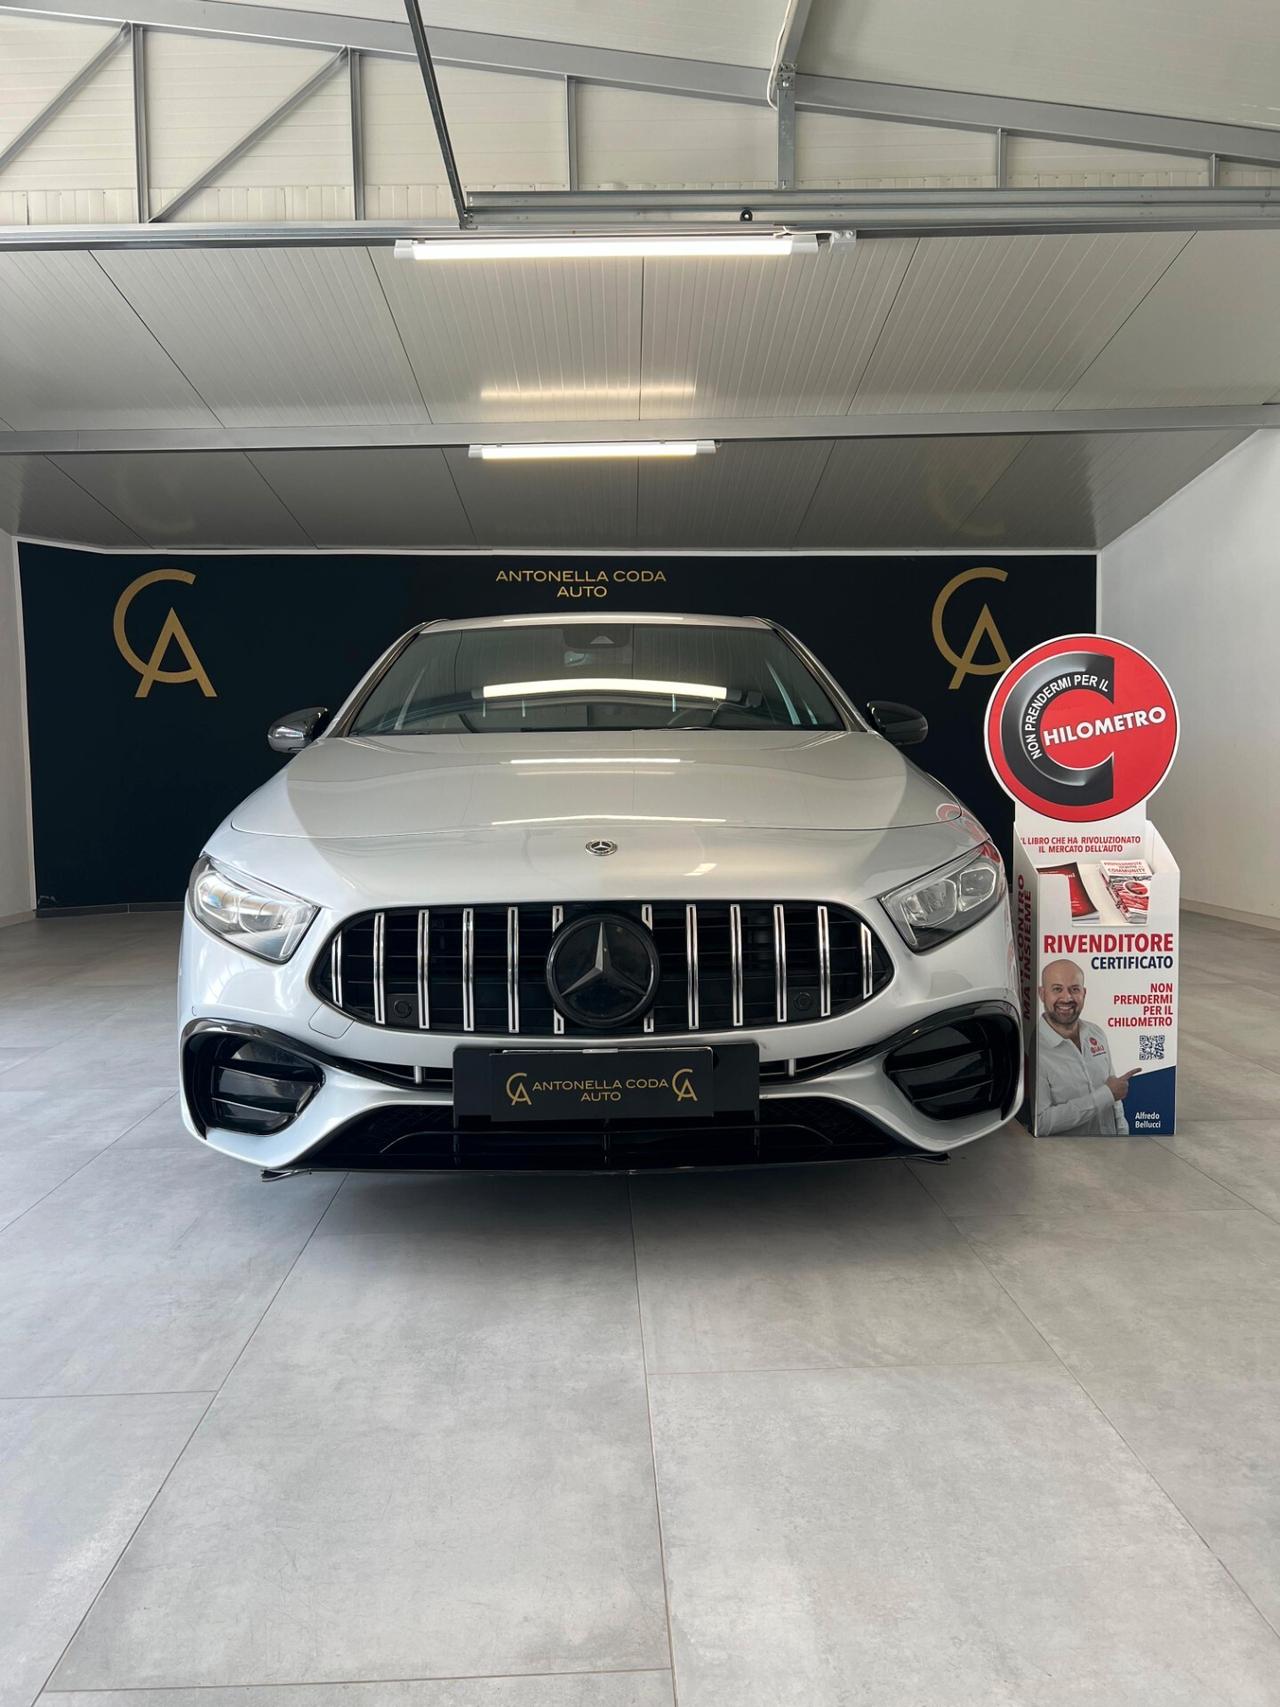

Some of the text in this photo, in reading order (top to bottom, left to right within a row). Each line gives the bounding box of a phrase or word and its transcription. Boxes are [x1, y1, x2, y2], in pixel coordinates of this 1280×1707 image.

[496, 570, 667, 582] ANTONELLA CODA
[557, 586, 607, 598] AUTO
[1024, 674, 1109, 760] NON PRENDERMI PER IL
[1028, 837, 1049, 845] LIBRO
[1051, 837, 1066, 845] CHE
[1068, 837, 1078, 845] HA
[1081, 836, 1141, 844] RIVOLUZIONATO
[1038, 845, 1123, 853] IL MERCATO DELL'AUTO
[1044, 934, 1173, 953] RIVENDITORE
[1091, 956, 1173, 969] CERTIFICATO
[1150, 983, 1173, 993] NON
[1023, 987, 1030, 1020] MA
[1114, 995, 1173, 1004] PRENDERMI
[1143, 1006, 1173, 1015] PER IL
[1108, 1017, 1173, 1027] CHILOMETRO
[532, 1078, 669, 1091] ANTONELLA CODA
[580, 1091, 622, 1102] AUTO
